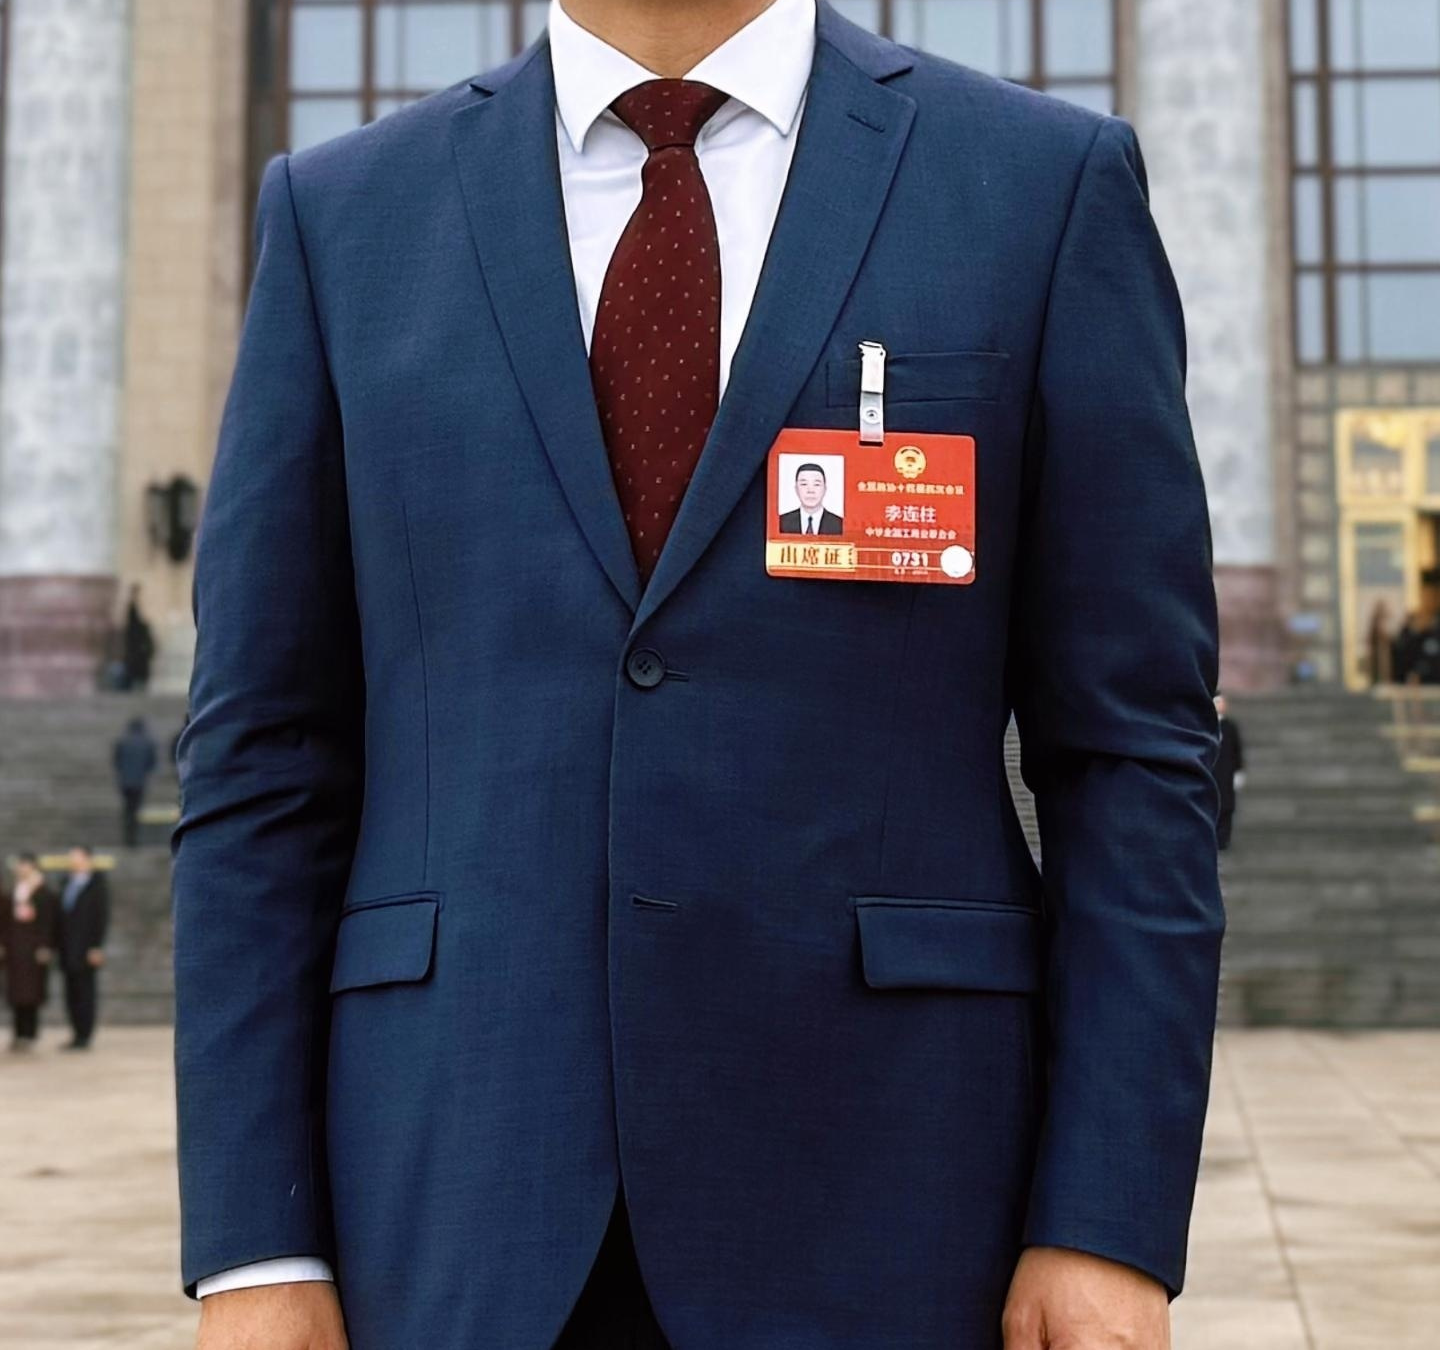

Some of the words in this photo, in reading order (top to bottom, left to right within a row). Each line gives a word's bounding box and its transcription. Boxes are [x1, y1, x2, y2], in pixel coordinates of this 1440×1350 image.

[885, 504, 937, 523] 李连柱
[780, 545, 842, 565] 出席证
[892, 552, 929, 566] 0731
